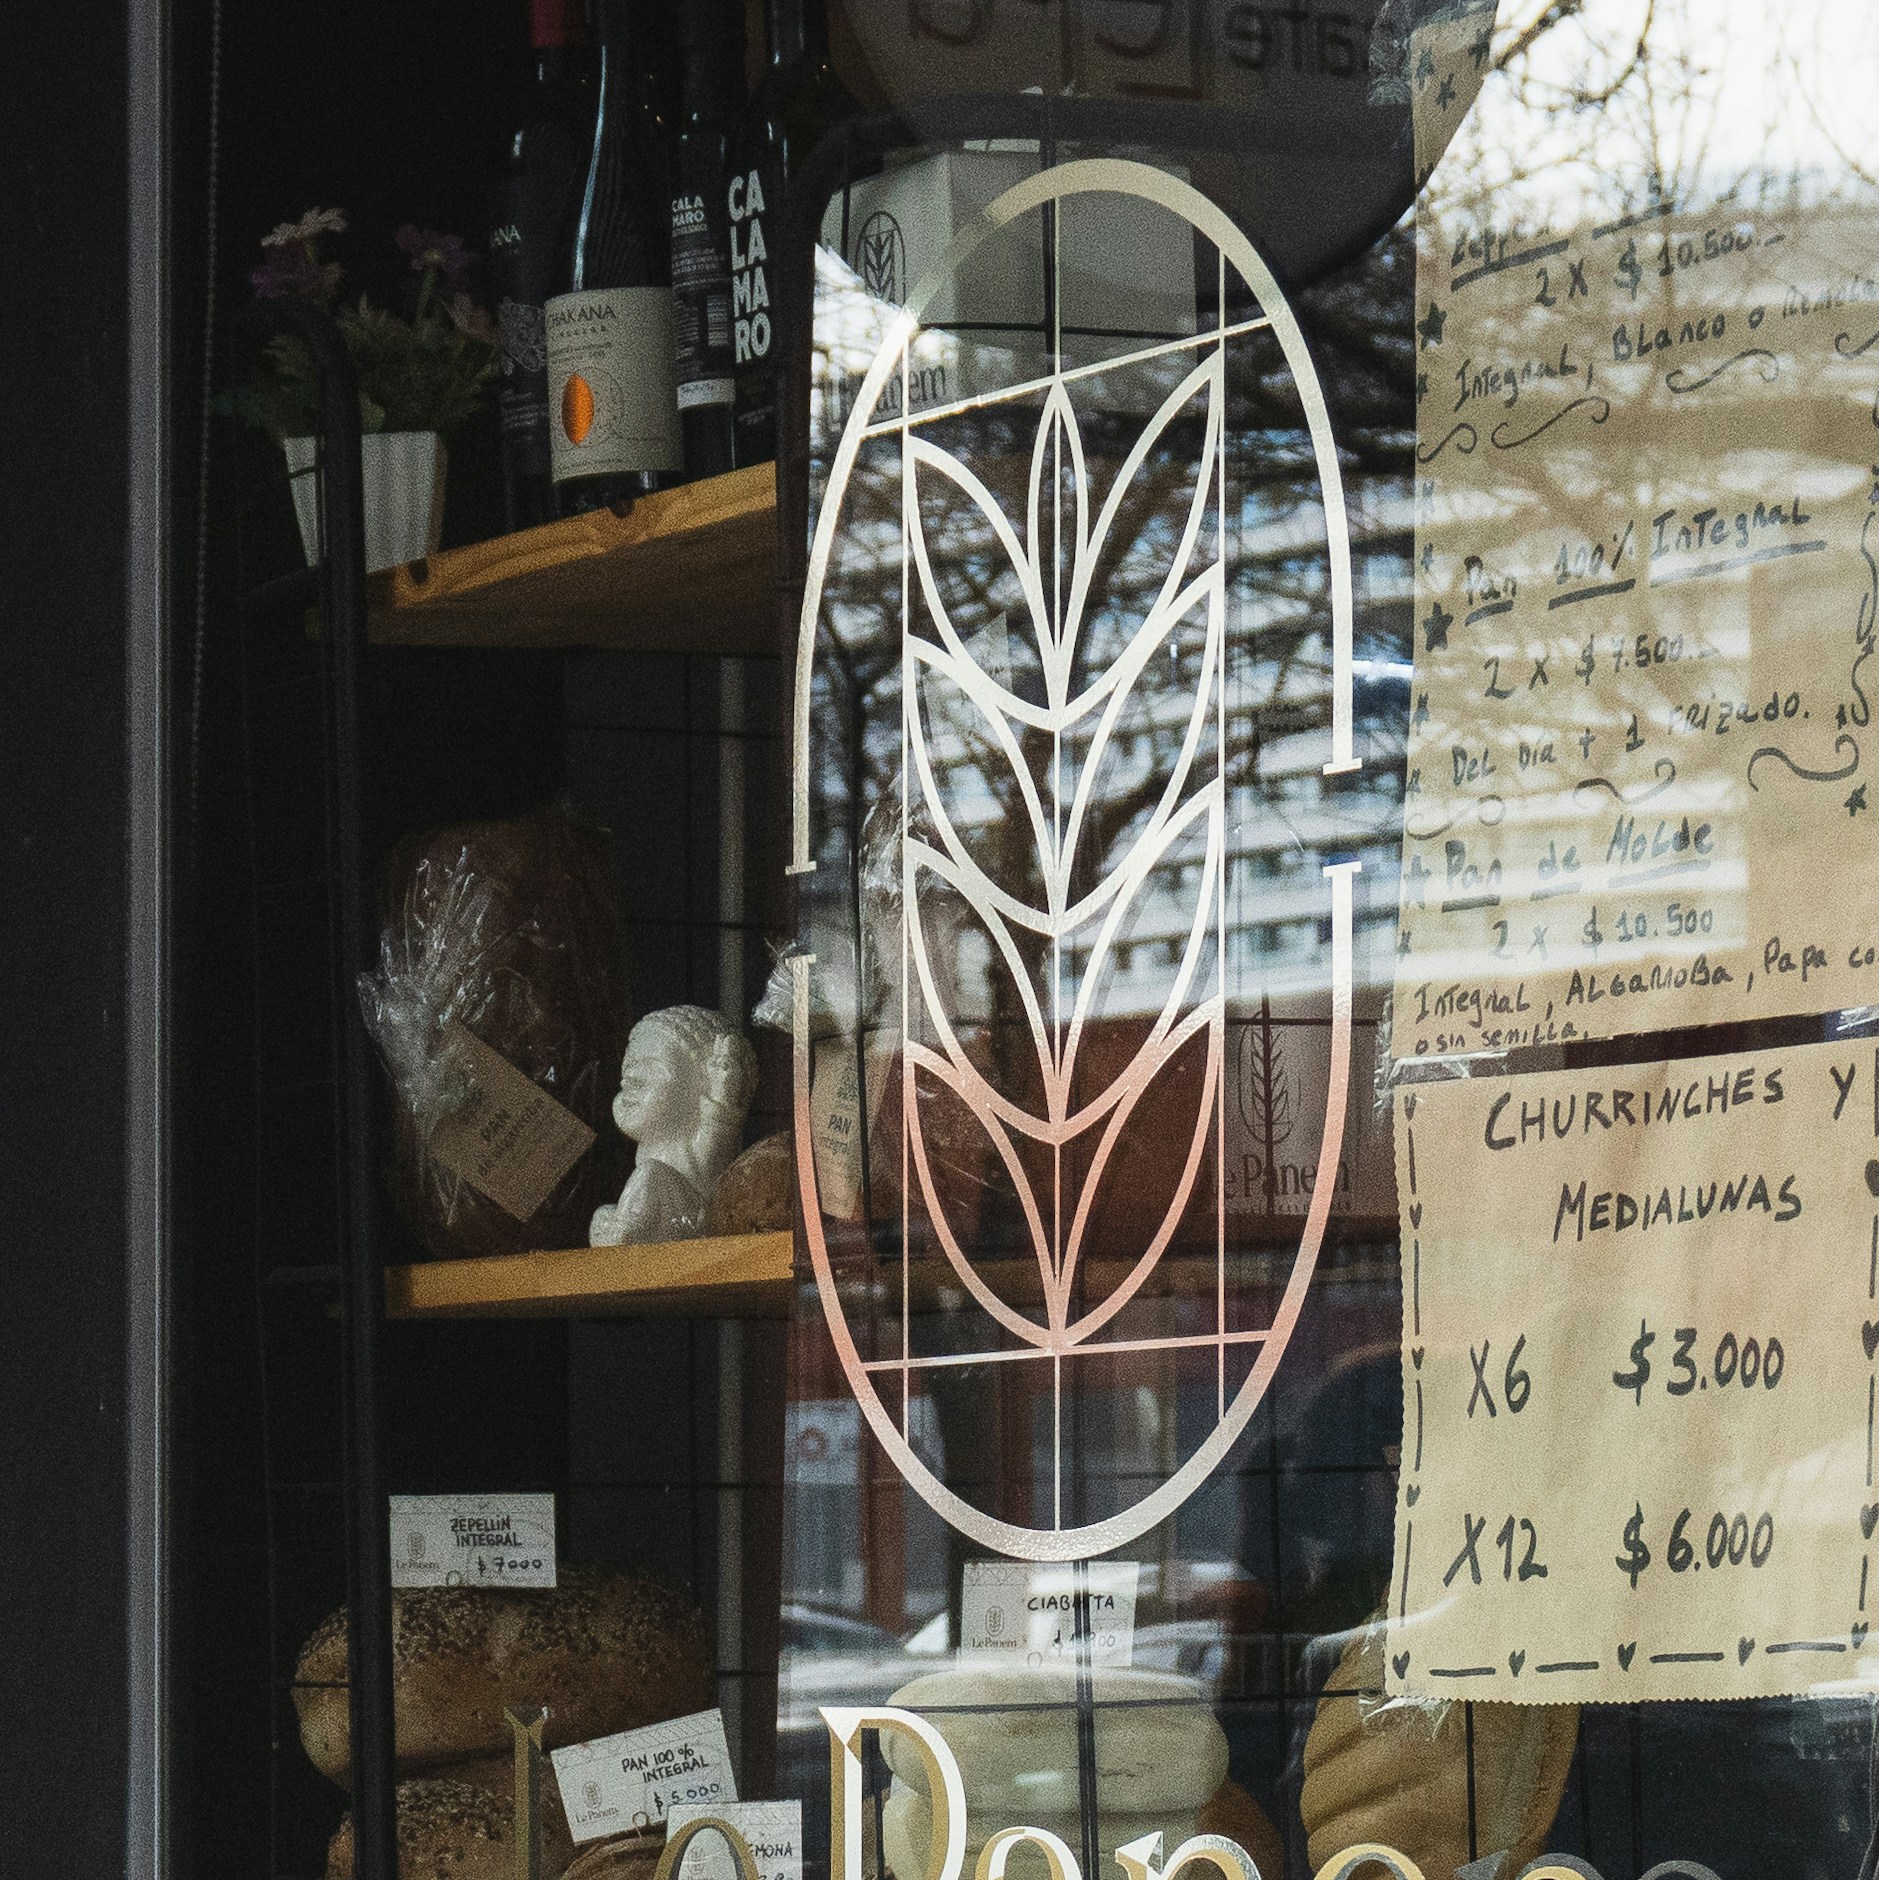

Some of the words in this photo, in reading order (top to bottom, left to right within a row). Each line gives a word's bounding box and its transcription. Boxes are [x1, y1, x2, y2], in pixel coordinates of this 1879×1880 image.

[730, 218, 767, 271] LA
[732, 266, 770, 318] MA
[1535, 268, 1556, 307] 2
[734, 312, 771, 364] RO
[1481, 655, 1512, 700] 2
[1624, 715, 1646, 752] 1
[1443, 838, 1502, 888] Pan
[1529, 840, 1582, 881] de
[1491, 918, 1511, 961] 2
[827, 1113, 853, 1136] PAN
[1483, 1064, 1787, 1151] CHURRINCHES
[1826, 1060, 1857, 1121] Y
[1552, 1174, 1804, 1244] MEDIALUNAS
[455, 1533, 523, 1548] INTEGRAL
[620, 1754, 649, 1774] PAN
[642, 1755, 710, 1784] INTEGRAL
